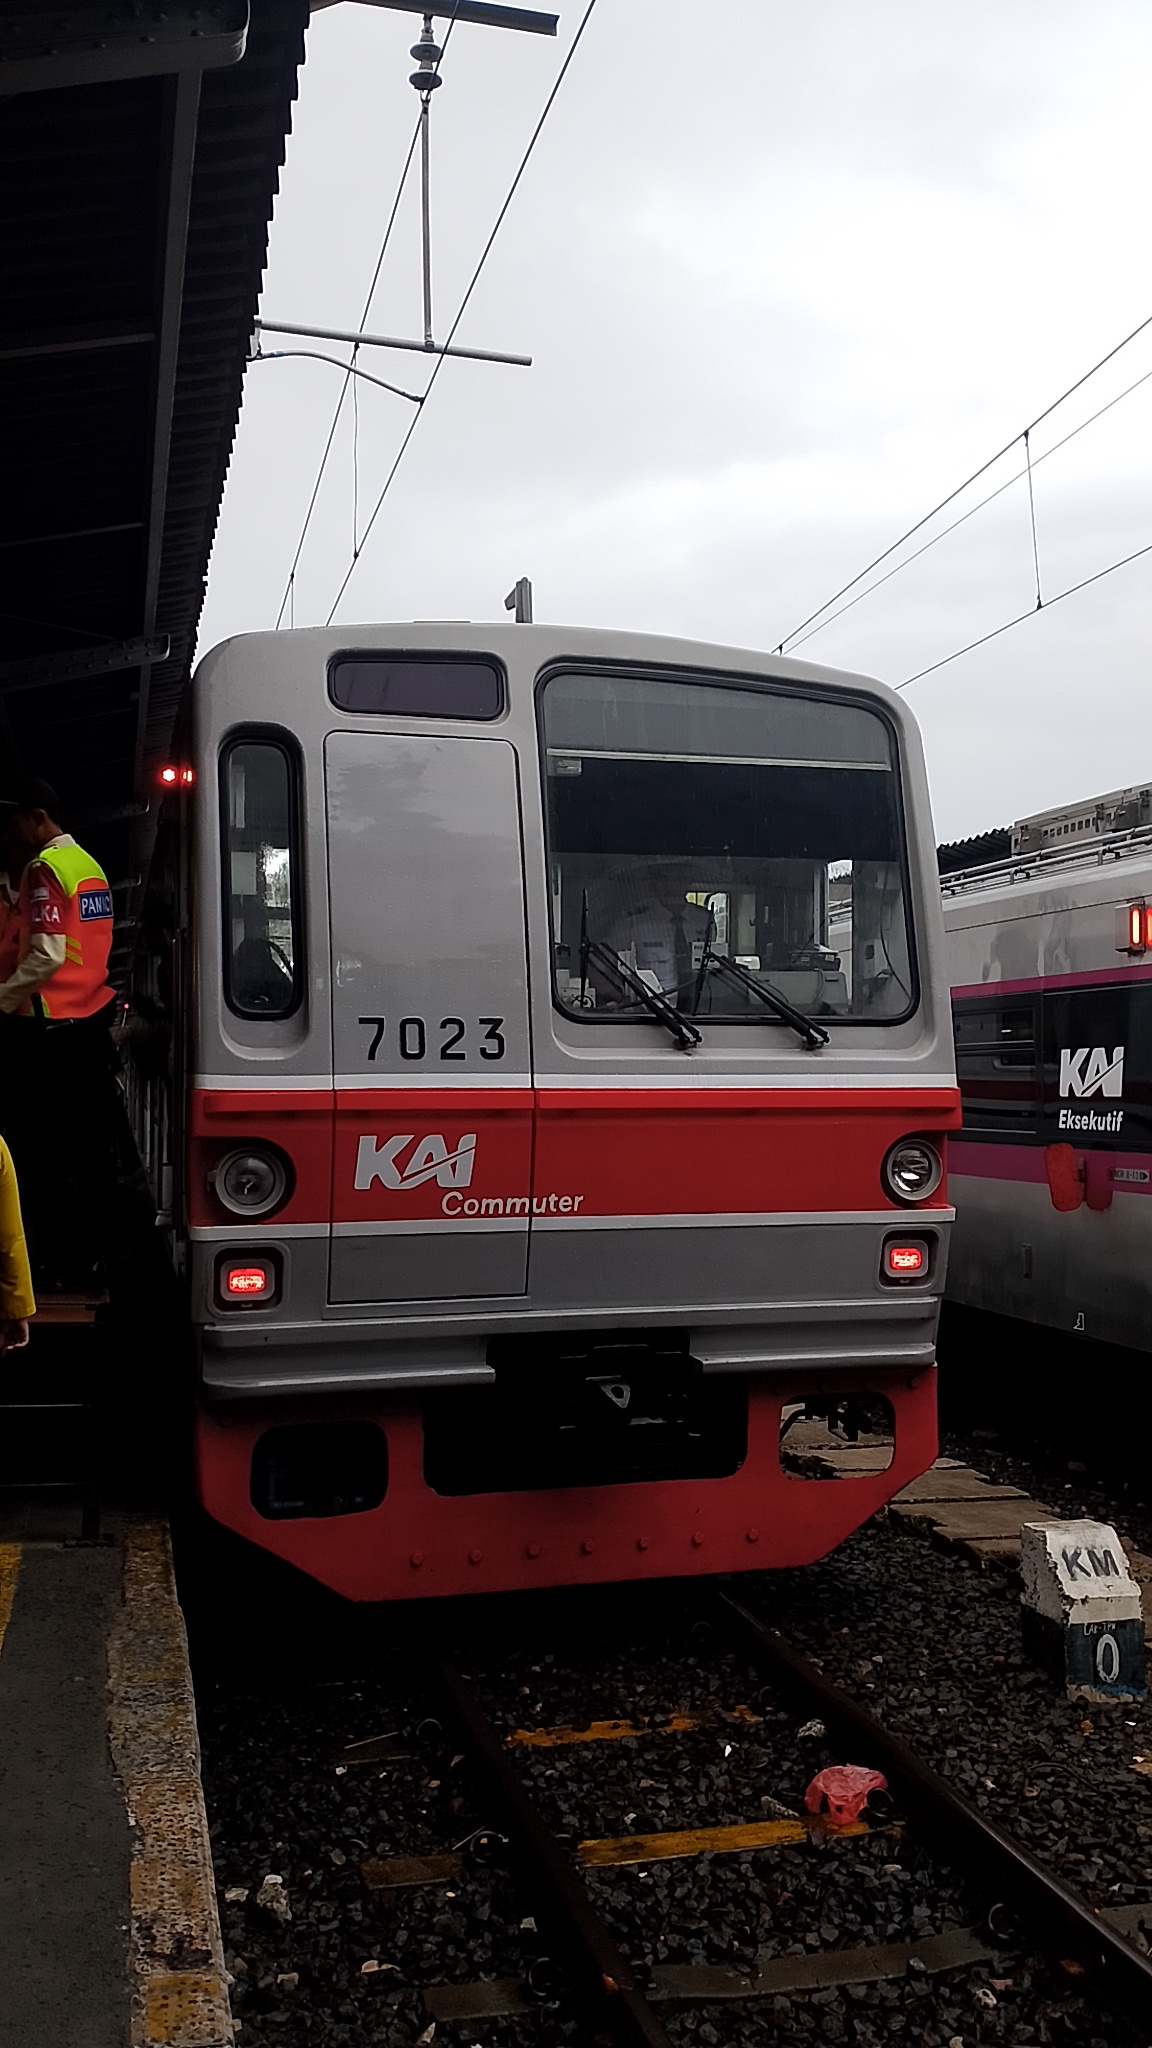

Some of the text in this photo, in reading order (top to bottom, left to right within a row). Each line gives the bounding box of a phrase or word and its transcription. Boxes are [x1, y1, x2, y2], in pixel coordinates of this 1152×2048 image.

[358, 1017, 505, 1061] 7023
[1059, 1046, 1124, 1097] KAI
[1058, 1109, 1124, 1132] Eksekutif
[354, 1133, 477, 1190] KAI
[441, 1191, 584, 1216] Commuter
[1061, 1547, 1120, 1580] KM
[1096, 1633, 1120, 1683] 0
